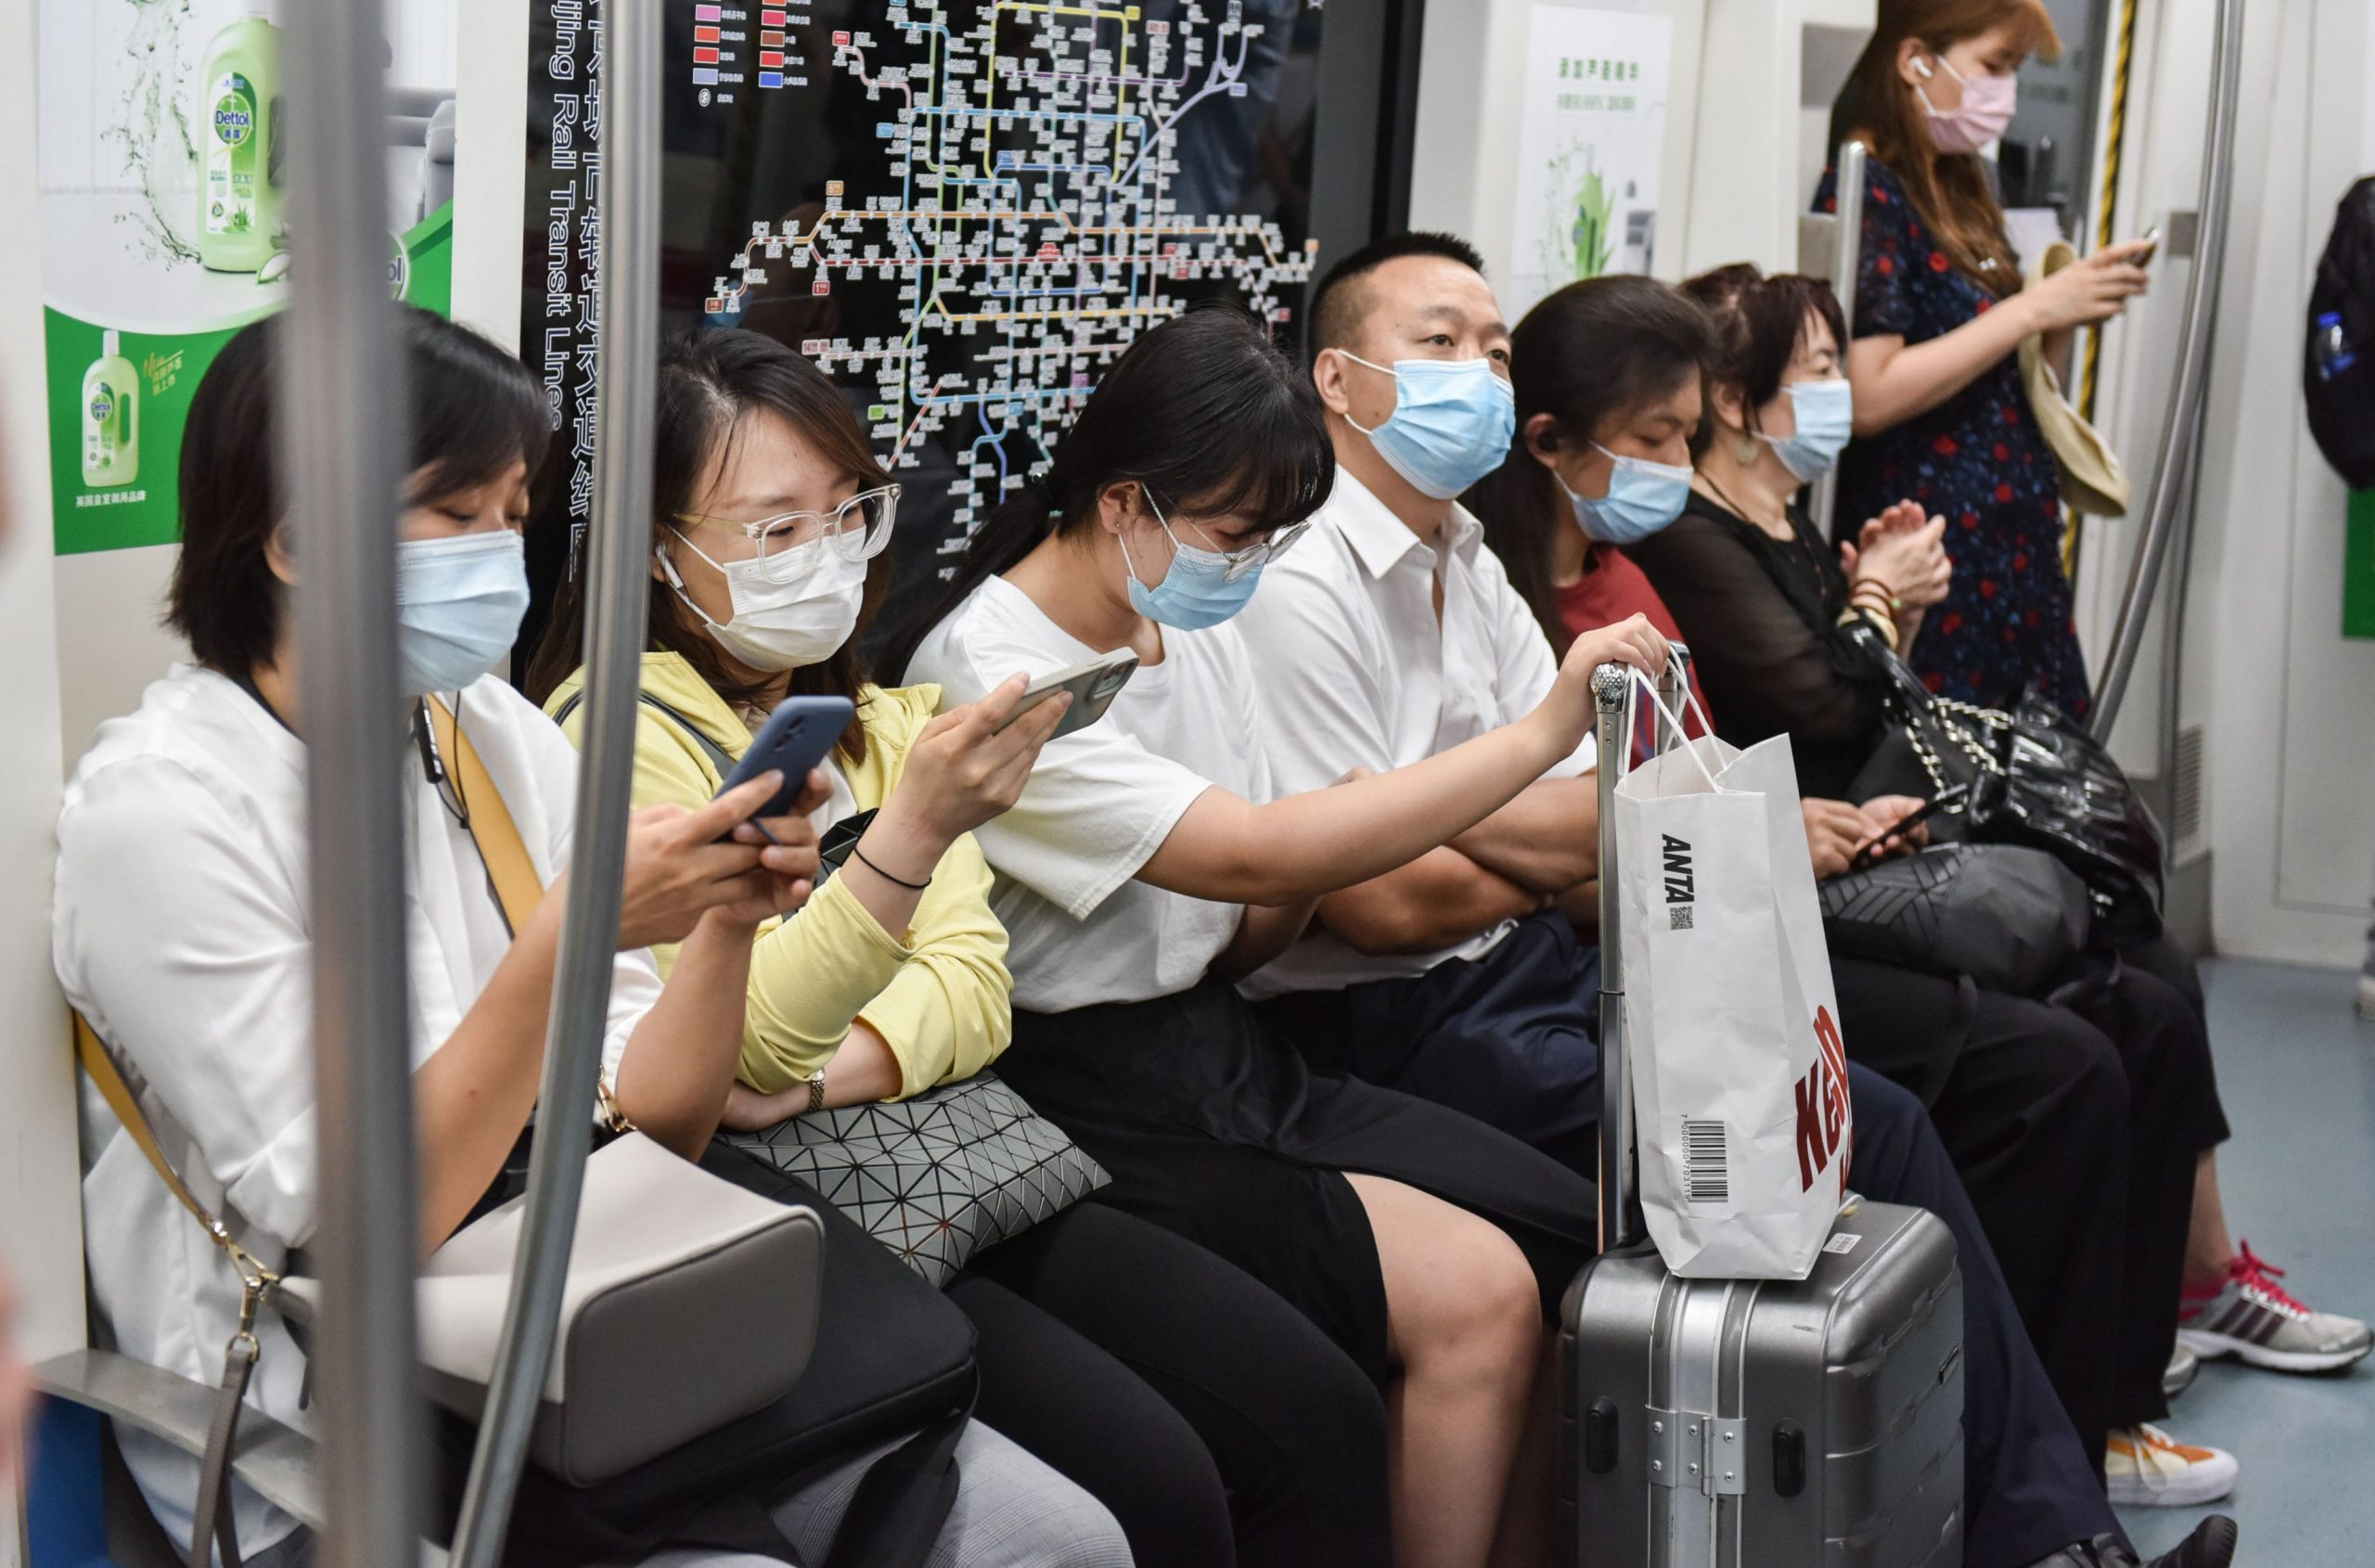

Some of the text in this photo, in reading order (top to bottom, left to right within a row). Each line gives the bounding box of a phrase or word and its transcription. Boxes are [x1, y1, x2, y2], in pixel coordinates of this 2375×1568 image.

[215, 109, 249, 125] Dettol
[551, 94, 579, 169] Rail
[546, 180, 576, 316] Transit
[1662, 833, 1695, 904] ANTA
